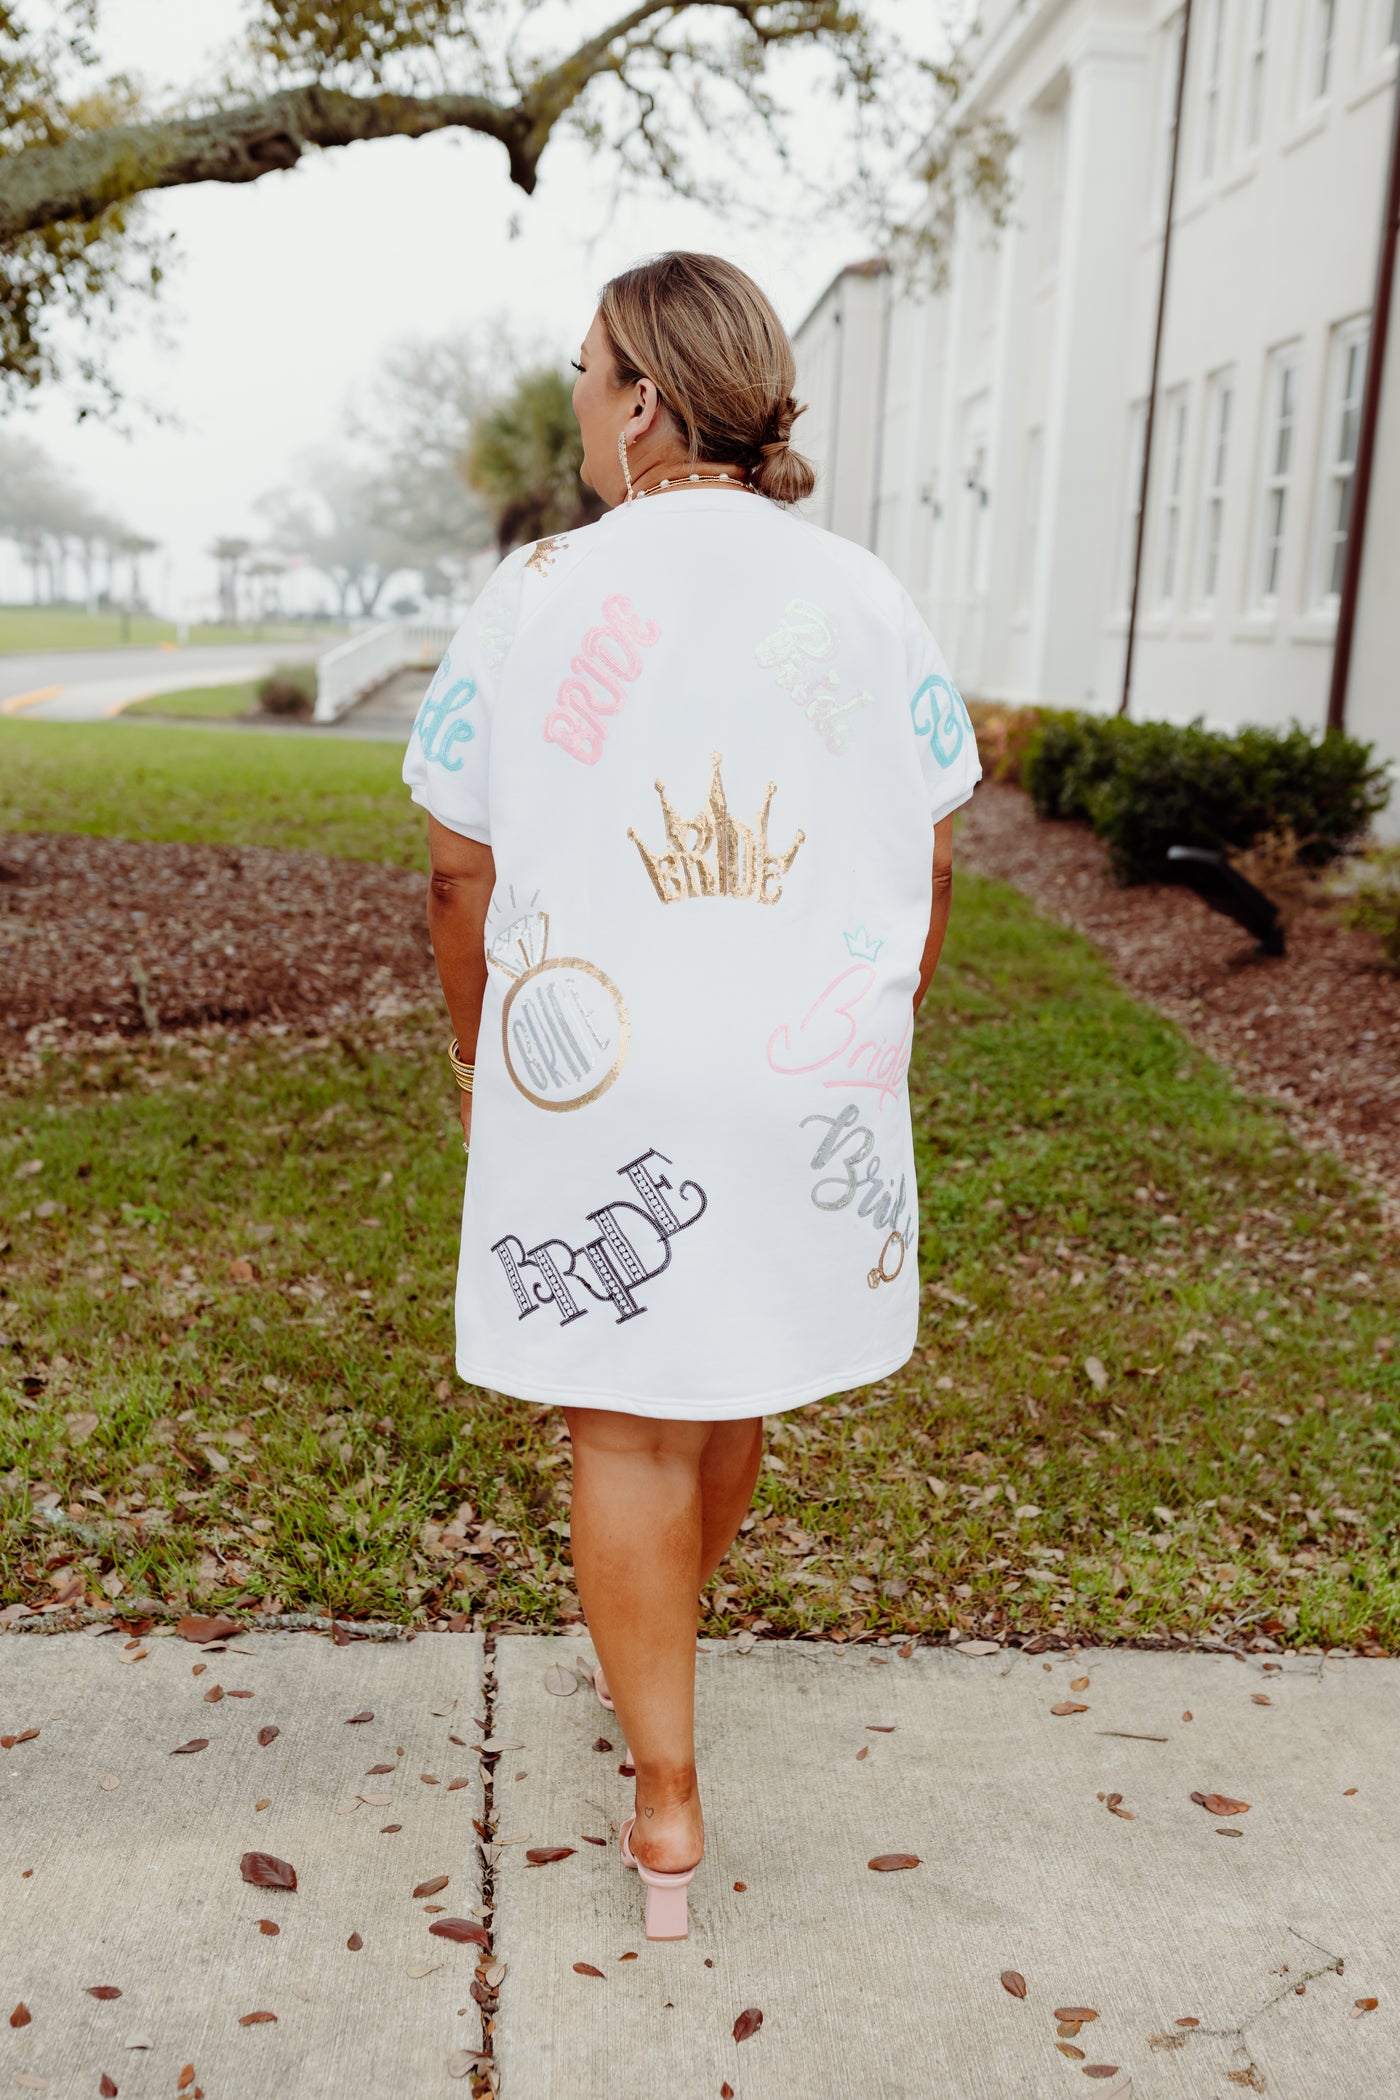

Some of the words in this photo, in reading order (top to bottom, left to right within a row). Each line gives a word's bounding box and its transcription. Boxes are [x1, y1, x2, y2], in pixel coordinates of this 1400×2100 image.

[543, 593, 662, 766] BRIDE
[639, 788, 790, 905] BRIDE
[490, 1147, 708, 1327] BRIDE
